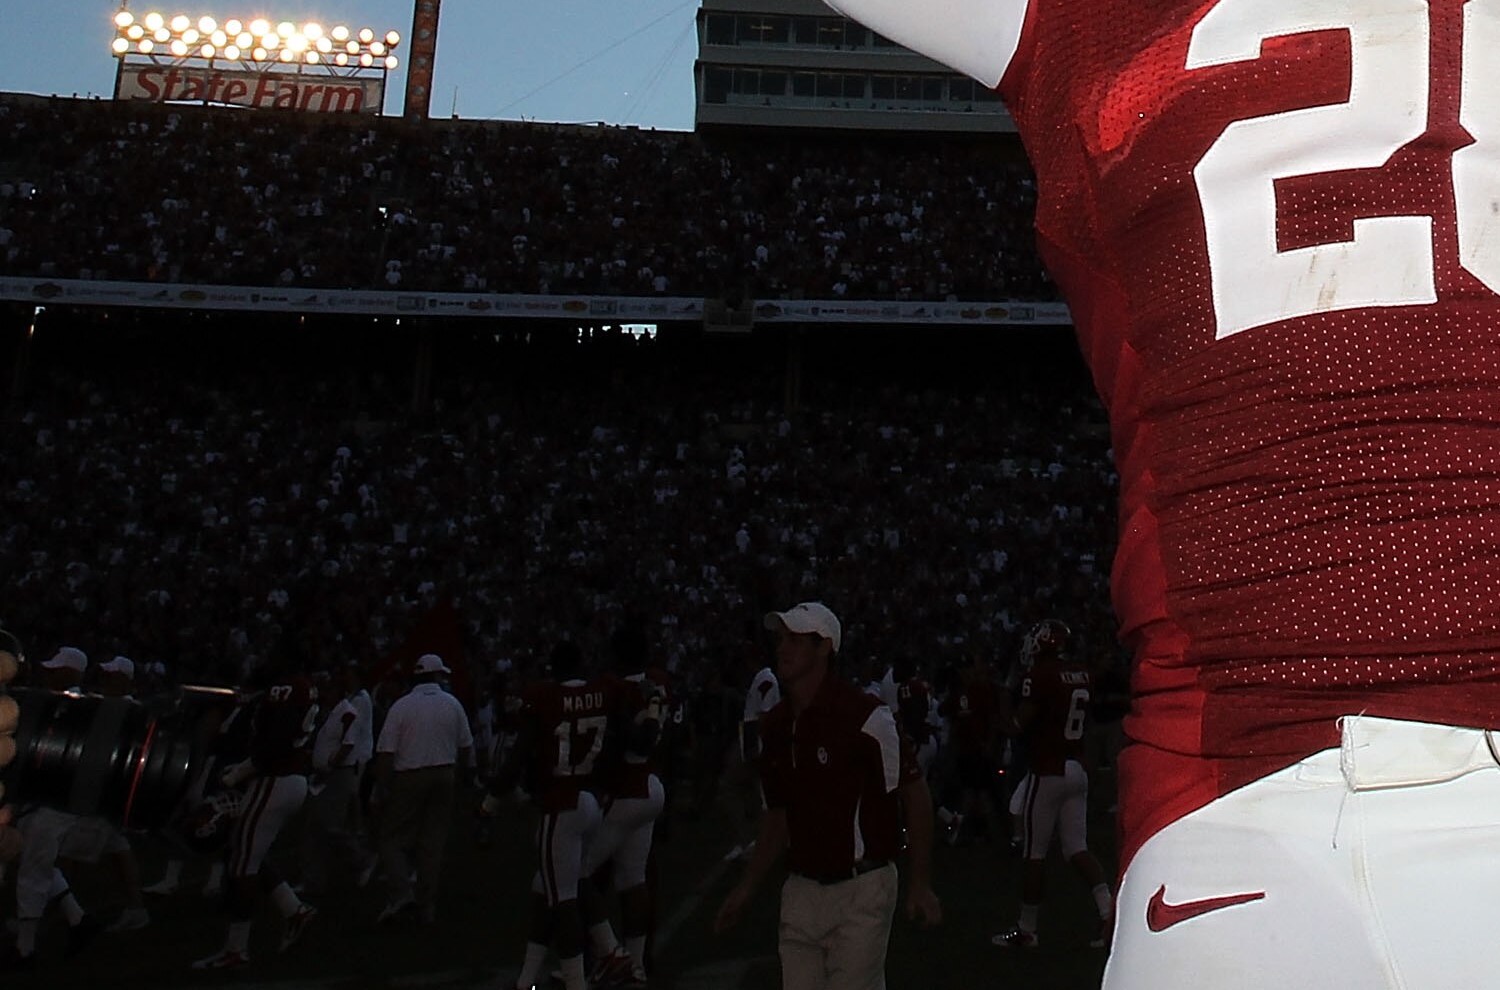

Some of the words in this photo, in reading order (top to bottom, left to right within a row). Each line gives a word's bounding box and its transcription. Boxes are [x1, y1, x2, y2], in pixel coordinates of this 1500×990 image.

[137, 67, 248, 104] State
[249, 73, 363, 114] Farm
[562, 691, 604, 713] MADU
[1021, 677, 1033, 698] 6
[1064, 688, 1090, 741] 6
[552, 715, 608, 777] 17
